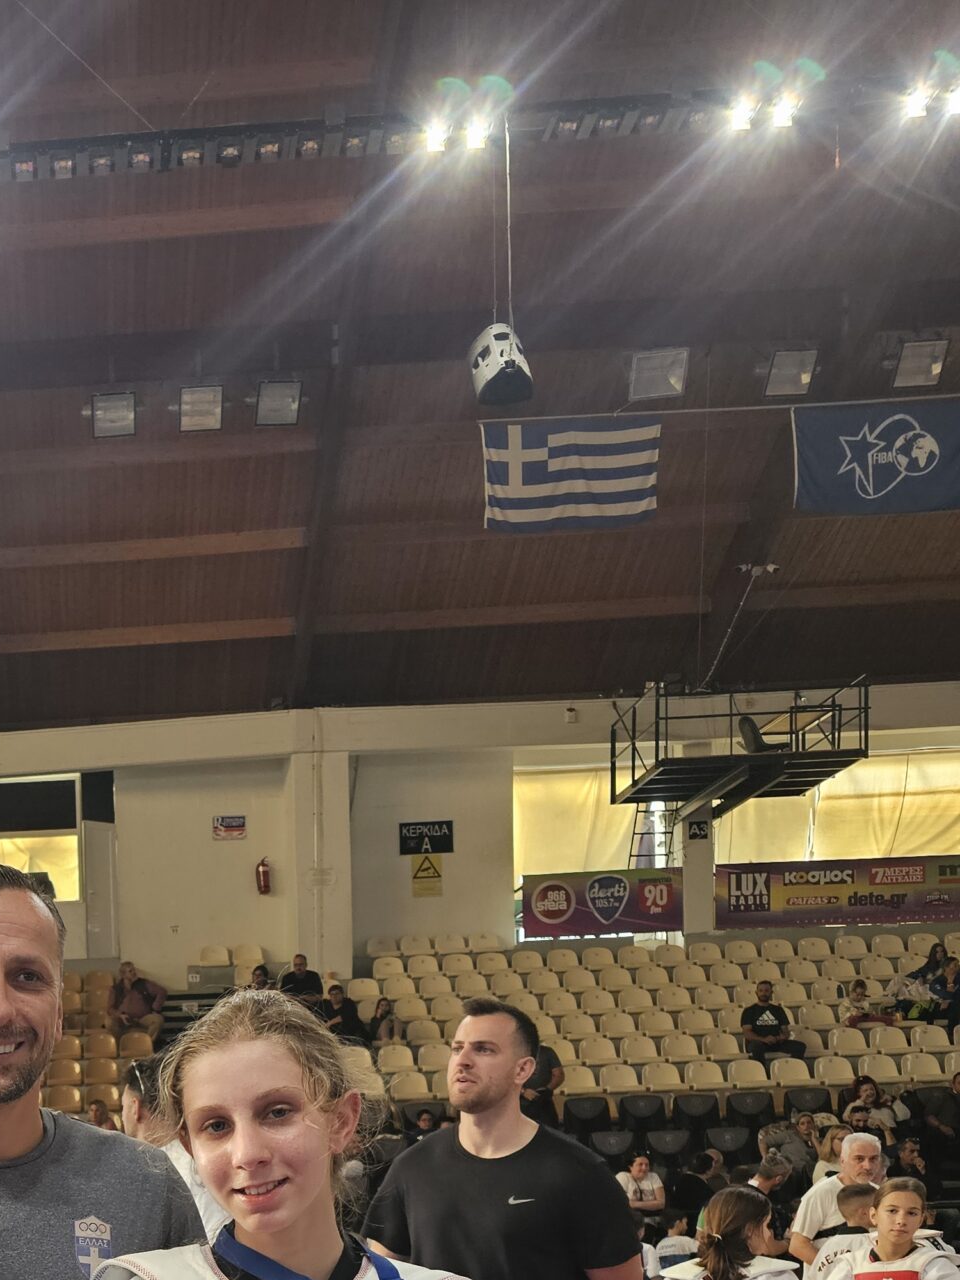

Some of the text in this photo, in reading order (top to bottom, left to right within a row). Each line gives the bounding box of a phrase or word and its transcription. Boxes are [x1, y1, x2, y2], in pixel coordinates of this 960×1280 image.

[873, 452, 893, 464] FIBA
[402, 824, 449, 837] ΚΕΡΚΙΔΑ
[871, 867, 884, 883] 7
[885, 866, 923, 876] ΜΕΡΕΣ
[730, 873, 768, 895] LUX
[644, 885, 668, 906] 90
[730, 895, 768, 905] RADIO
[789, 896, 829, 905] PATRAS
[78, 1237, 109, 1248] ΕΛΛΑΣ
